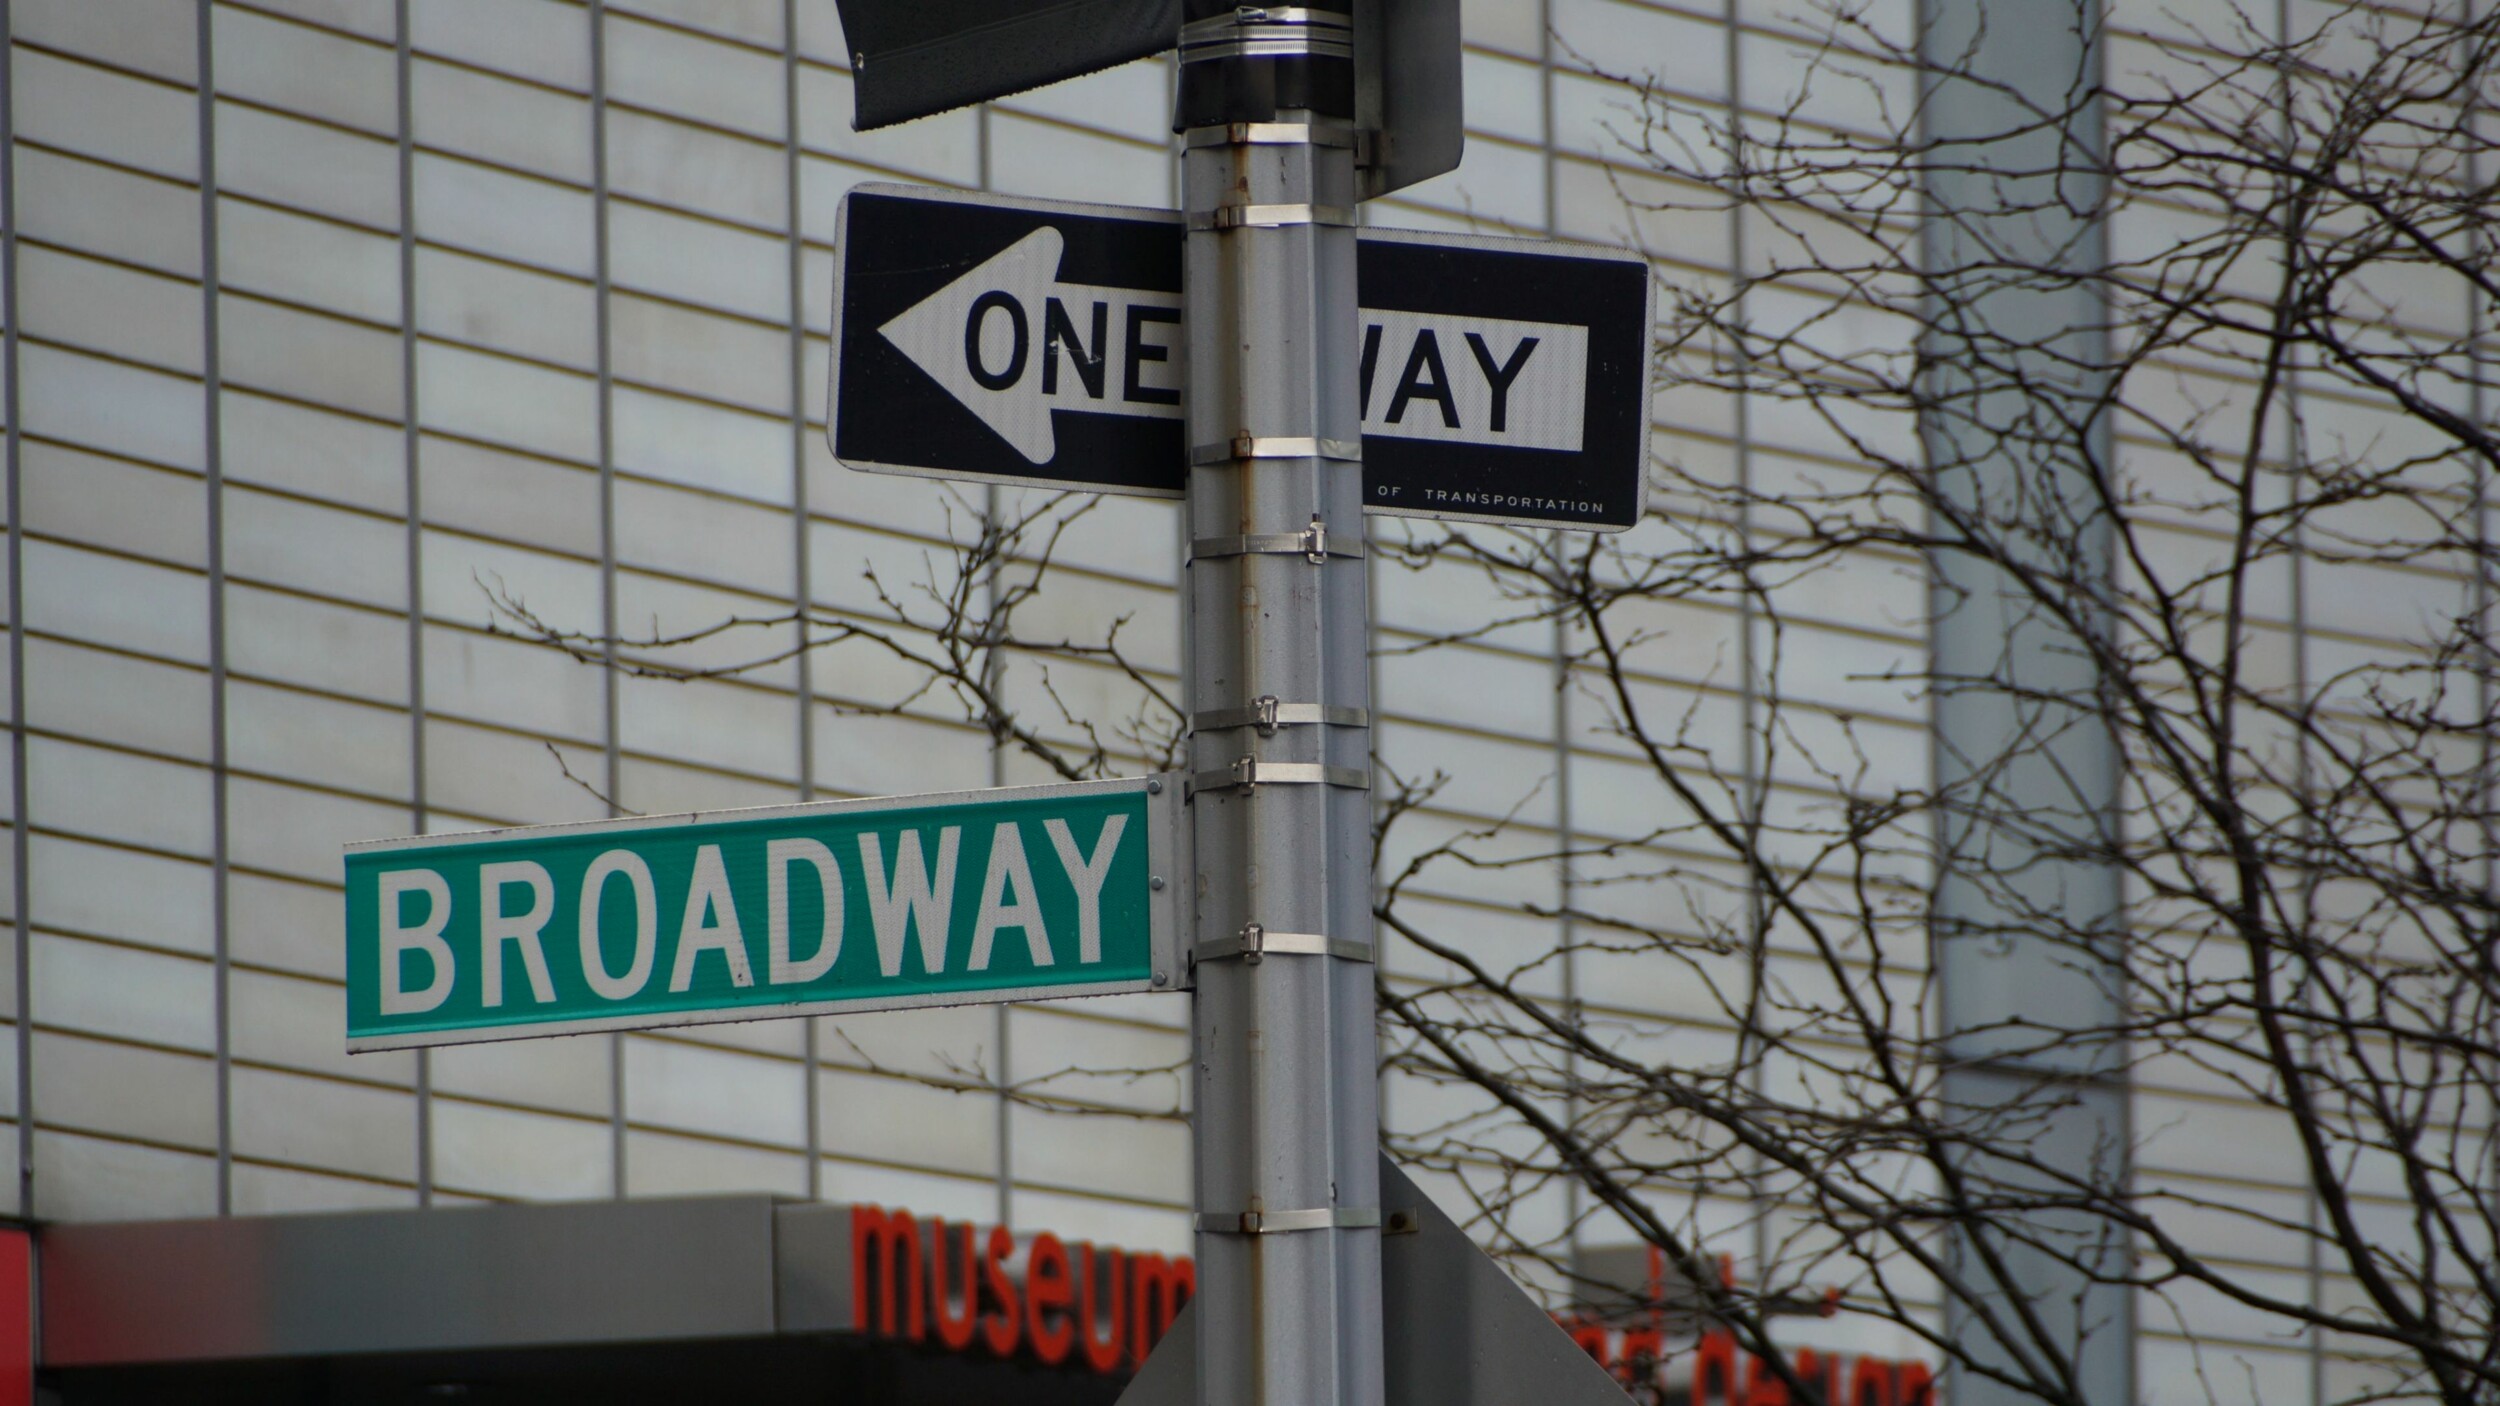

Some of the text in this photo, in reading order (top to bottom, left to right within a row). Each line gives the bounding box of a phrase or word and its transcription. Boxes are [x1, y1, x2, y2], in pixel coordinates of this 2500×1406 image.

[964, 289, 1541, 433] ONE AY
[1377, 485, 1604, 514] OF TRANSPORTATION
[378, 813, 1129, 1016] BROADWAY
[850, 1203, 1197, 1374] museum
